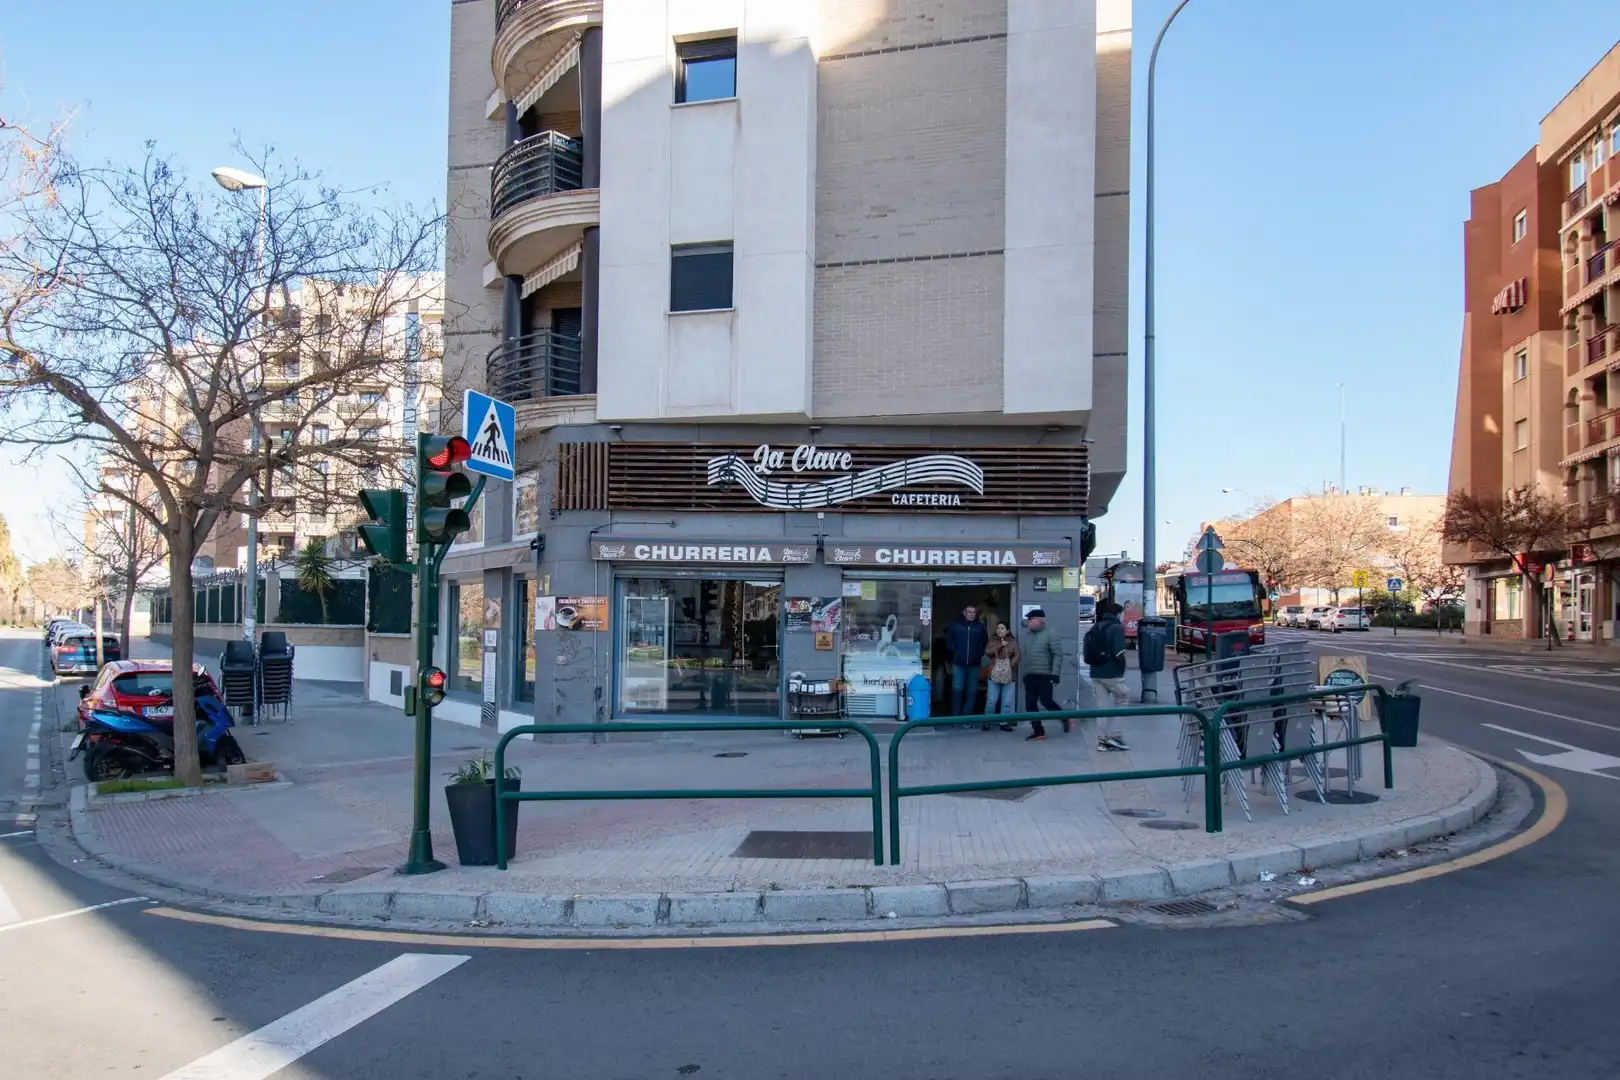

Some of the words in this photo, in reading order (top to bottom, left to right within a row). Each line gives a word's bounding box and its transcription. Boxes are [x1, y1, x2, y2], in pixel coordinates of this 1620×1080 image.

[753, 444, 784, 475] La
[792, 444, 853, 473] Clave
[891, 493, 961, 507] CAFETERIA
[634, 544, 773, 562] CHURRERIA
[875, 548, 1017, 566] CHURRERIA
